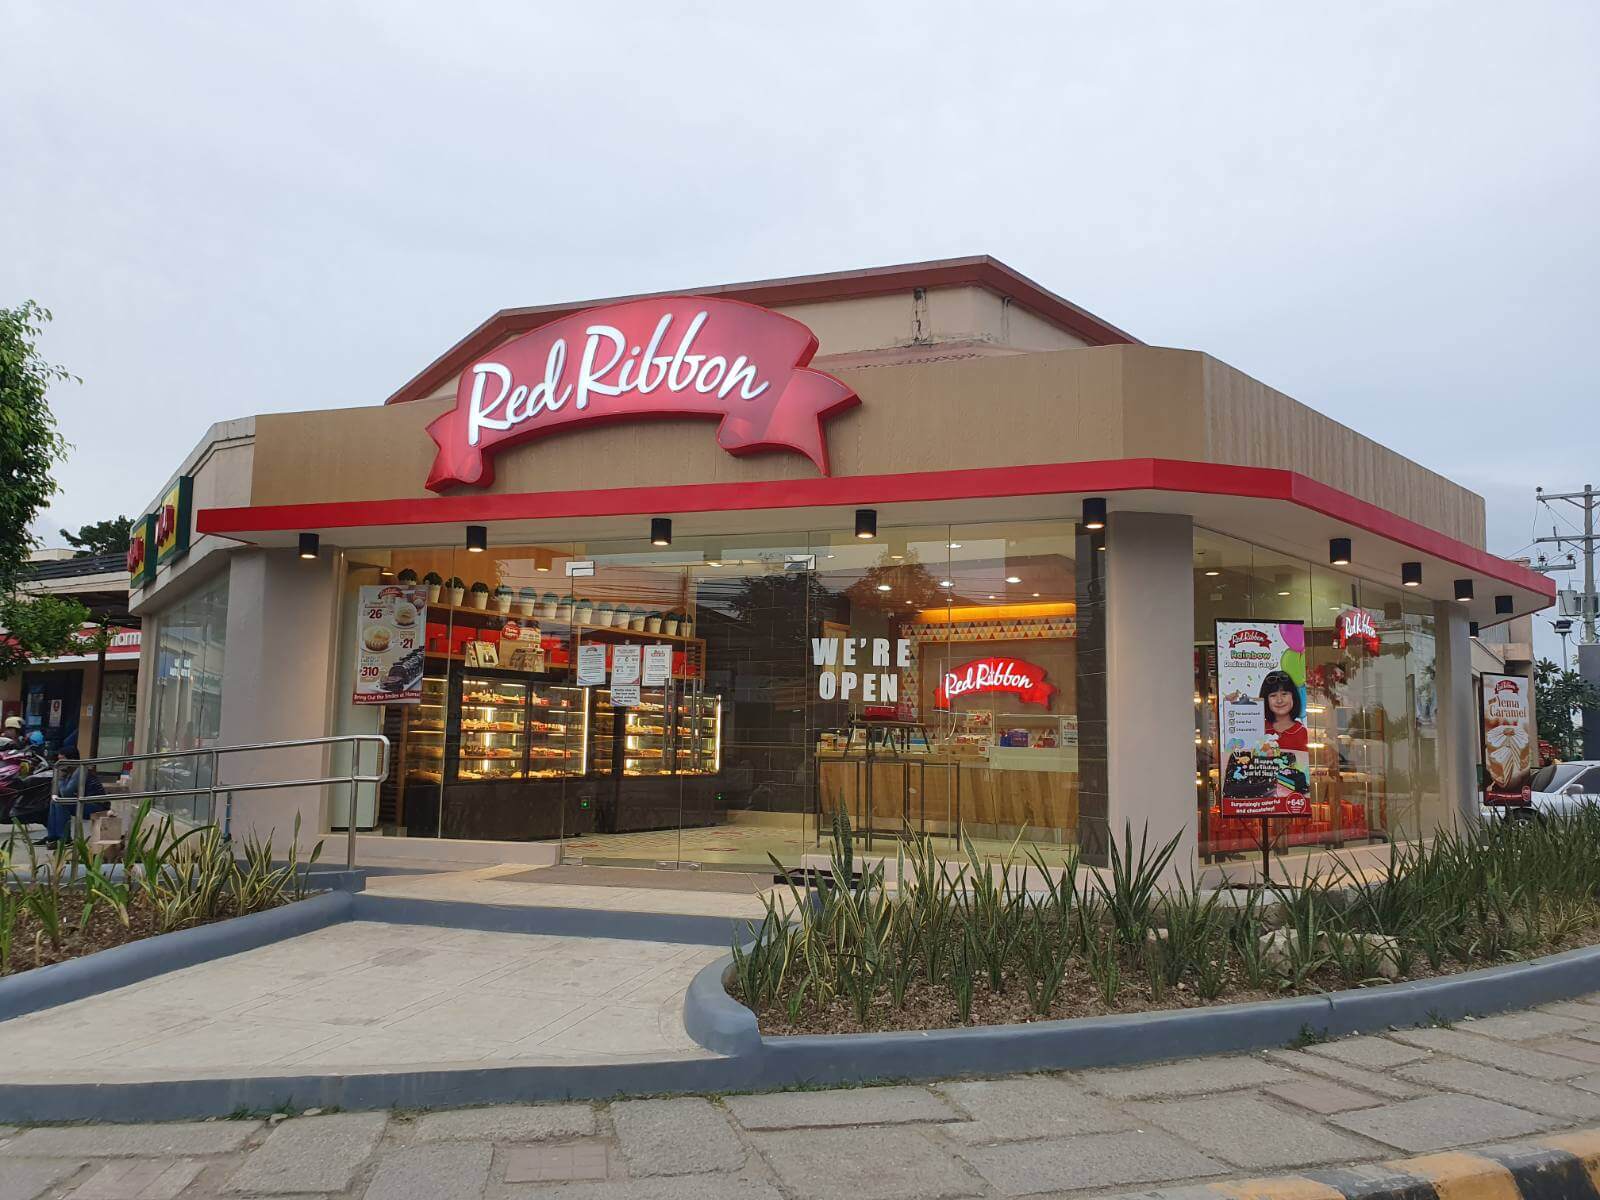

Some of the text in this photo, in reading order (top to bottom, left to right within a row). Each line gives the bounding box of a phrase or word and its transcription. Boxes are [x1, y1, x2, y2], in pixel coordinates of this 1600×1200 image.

[468, 311, 771, 446] Red Ribbon
[1232, 631, 1265, 644] Red Ribbon
[811, 638, 911, 667] WE'RE
[1231, 650, 1271, 660] Rainbow
[819, 672, 898, 703] OPEN
[945, 662, 1034, 699] Red Ribbon
[1490, 706, 1526, 718] Caramel
[1497, 696, 1520, 708] Yema
